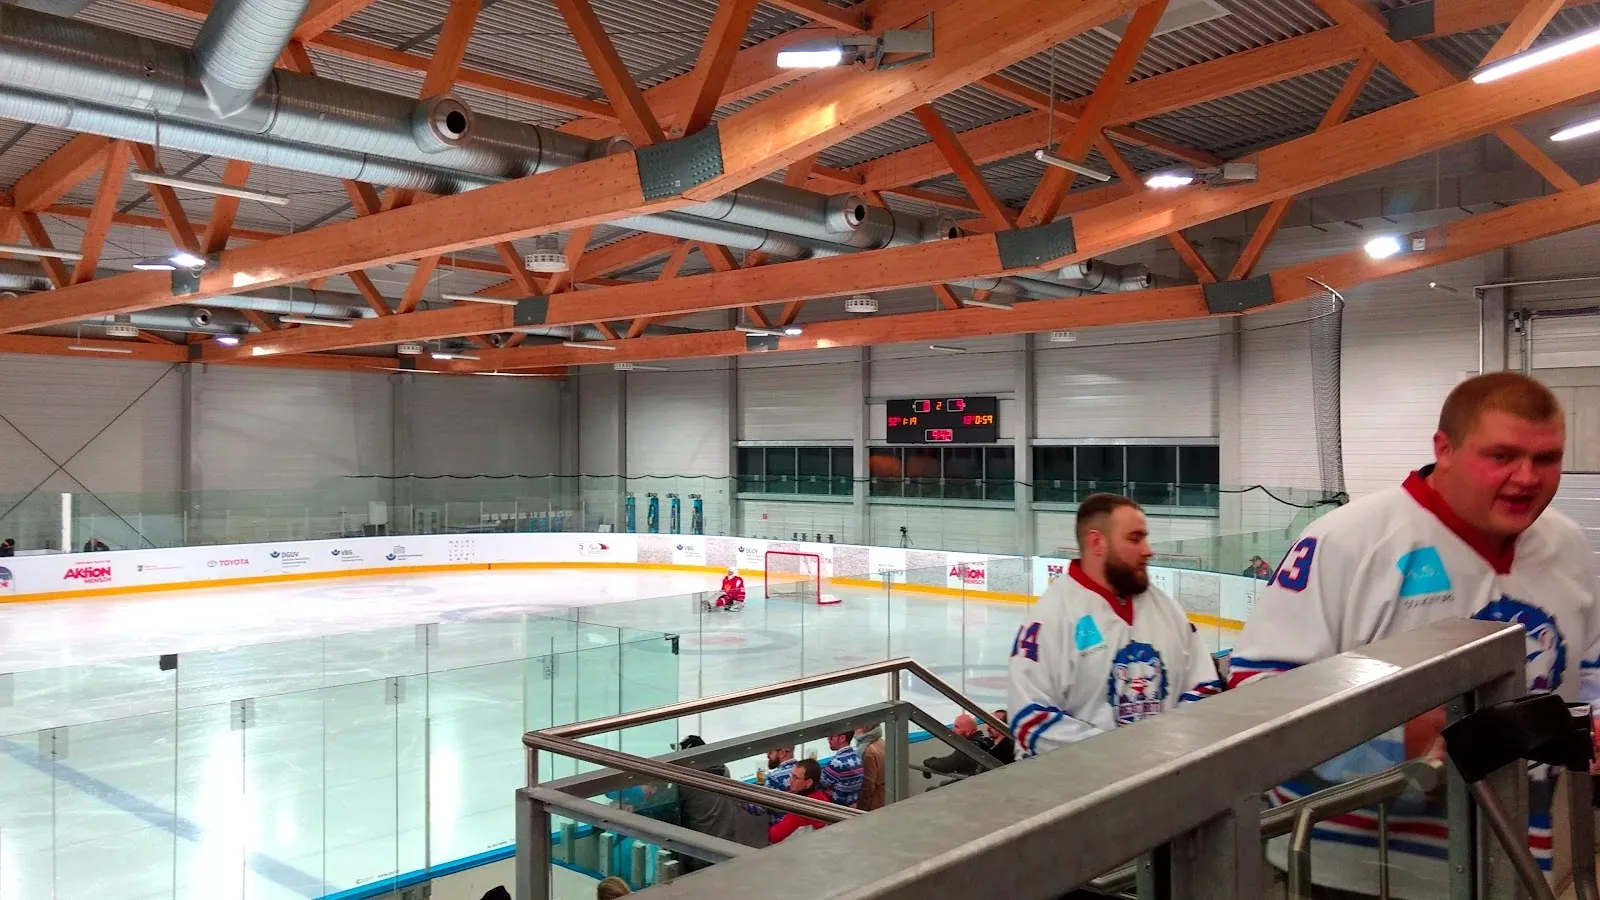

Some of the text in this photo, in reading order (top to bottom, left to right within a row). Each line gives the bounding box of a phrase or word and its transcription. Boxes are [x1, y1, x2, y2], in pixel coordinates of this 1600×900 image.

[936, 401, 942, 411] 2
[903, 416, 917, 426] 1:19
[975, 414, 993, 425] 0:59
[219, 559, 249, 567] TOYOTA
